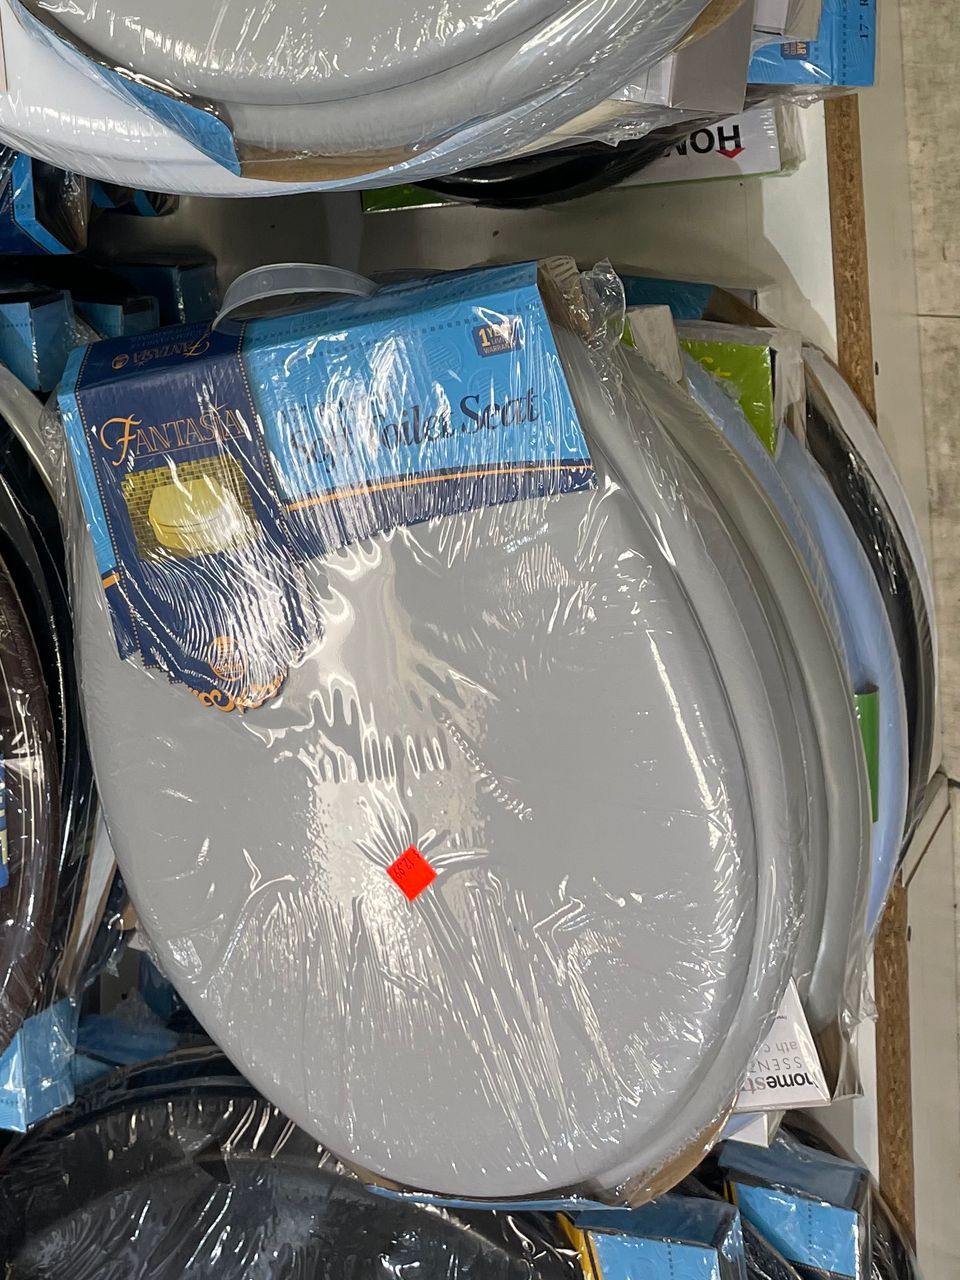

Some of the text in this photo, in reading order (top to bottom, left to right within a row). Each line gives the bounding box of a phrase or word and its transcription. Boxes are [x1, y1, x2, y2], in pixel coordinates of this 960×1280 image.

[460, 387, 541, 435] Seat
[100, 414, 246, 466] FANTASIA
[777, 1041, 798, 1054] ath
